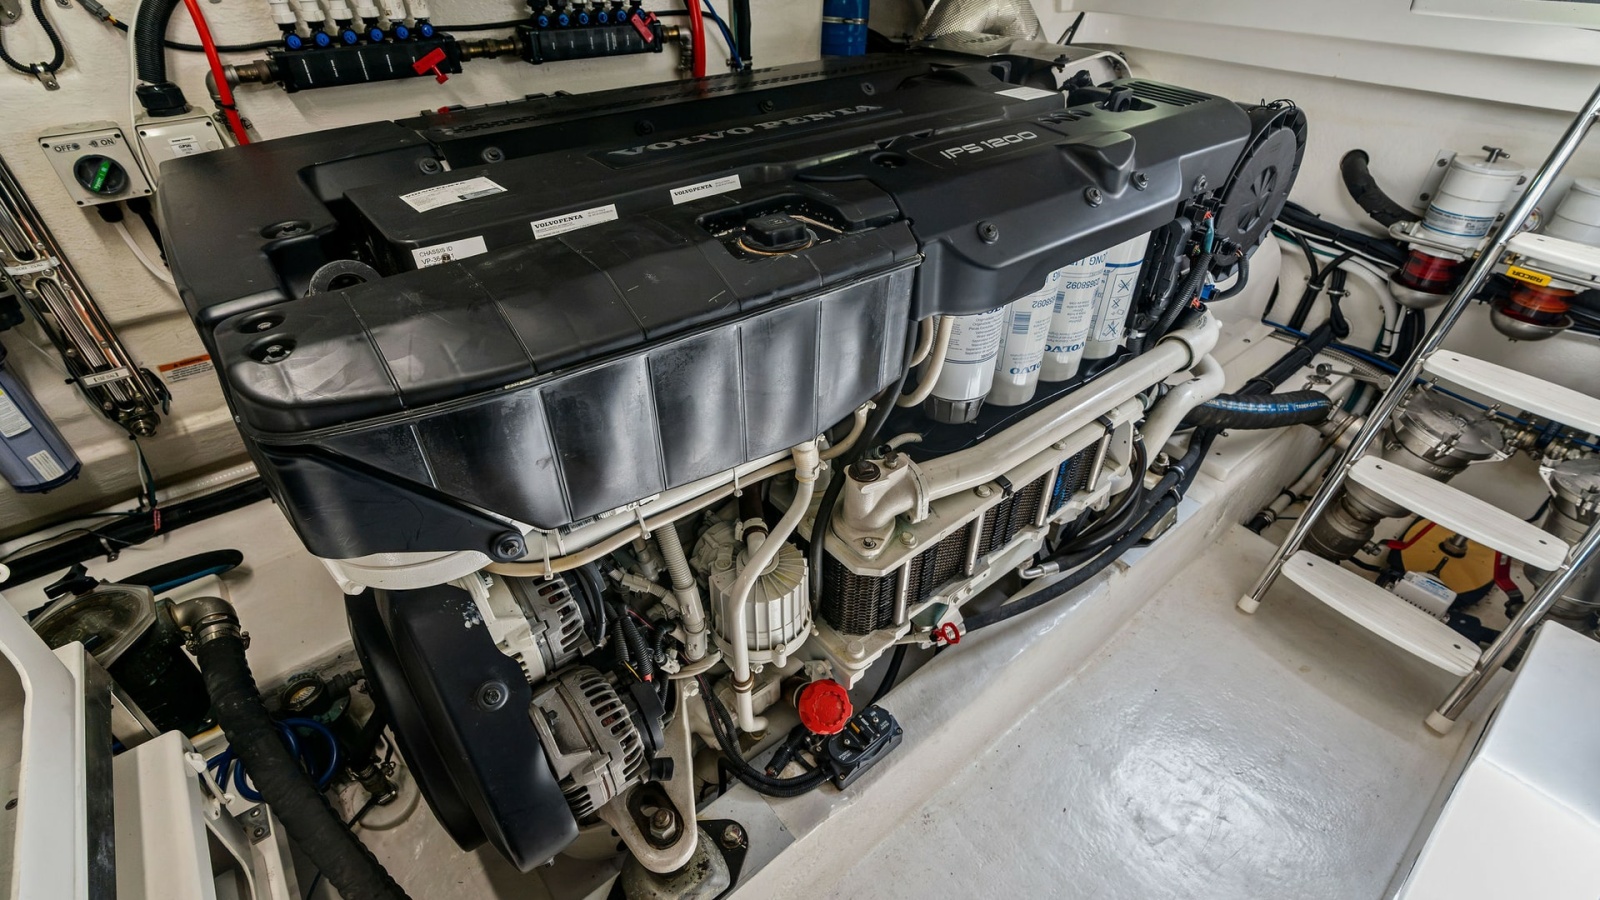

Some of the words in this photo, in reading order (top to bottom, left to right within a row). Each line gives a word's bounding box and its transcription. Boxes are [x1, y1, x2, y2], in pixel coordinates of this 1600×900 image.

[607, 126, 754, 156] VOLVO
[754, 105, 883, 132] PENTA
[54, 144, 73, 153] OFF
[100, 138, 115, 146] ON
[939, 143, 984, 160] IPS
[980, 131, 1038, 149] 1200
[419, 248, 446, 258] CHASSIS
[1009, 361, 1042, 375] OLVO
